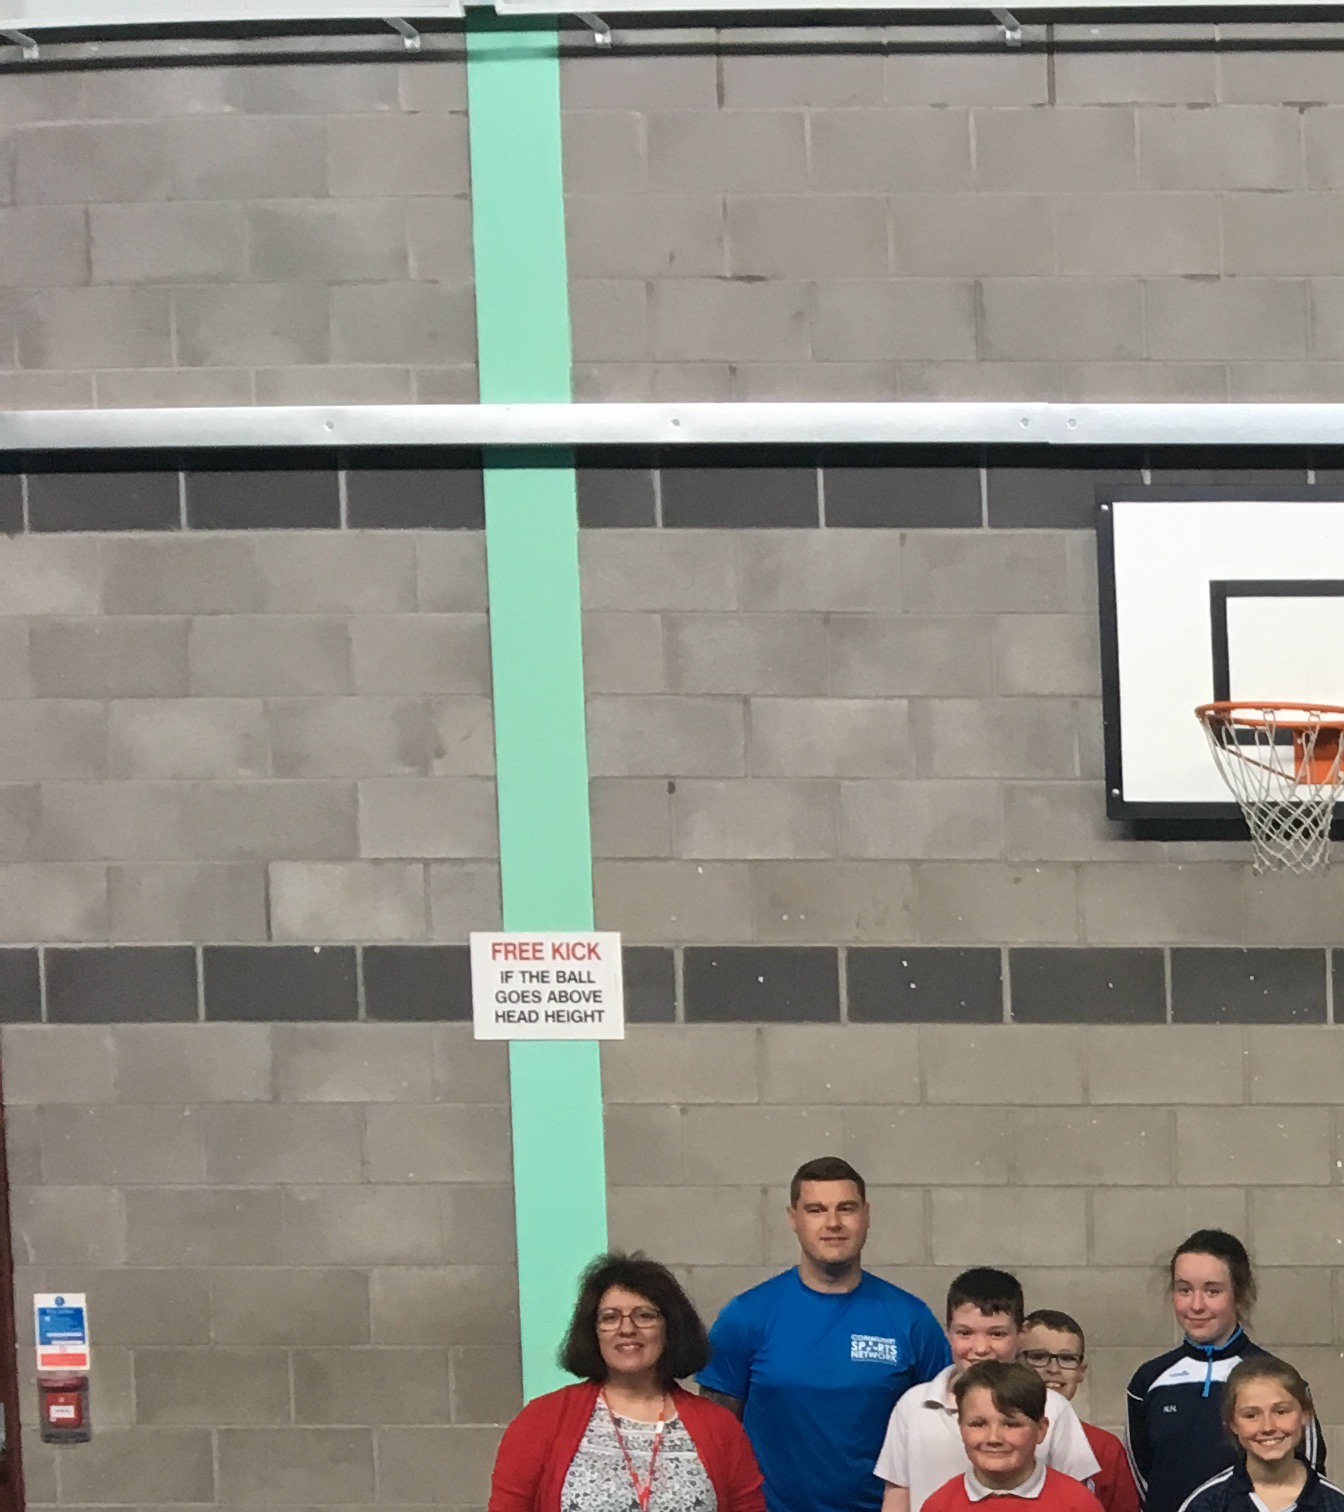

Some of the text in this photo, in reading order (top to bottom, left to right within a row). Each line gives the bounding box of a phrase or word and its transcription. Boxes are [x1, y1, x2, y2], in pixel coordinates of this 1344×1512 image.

[491, 942, 601, 961] FREE KICK
[500, 970, 596, 984] IF THE BALL
[495, 990, 603, 1003] GOES ABOVE
[494, 1010, 605, 1023] HEAD HEIGHT
